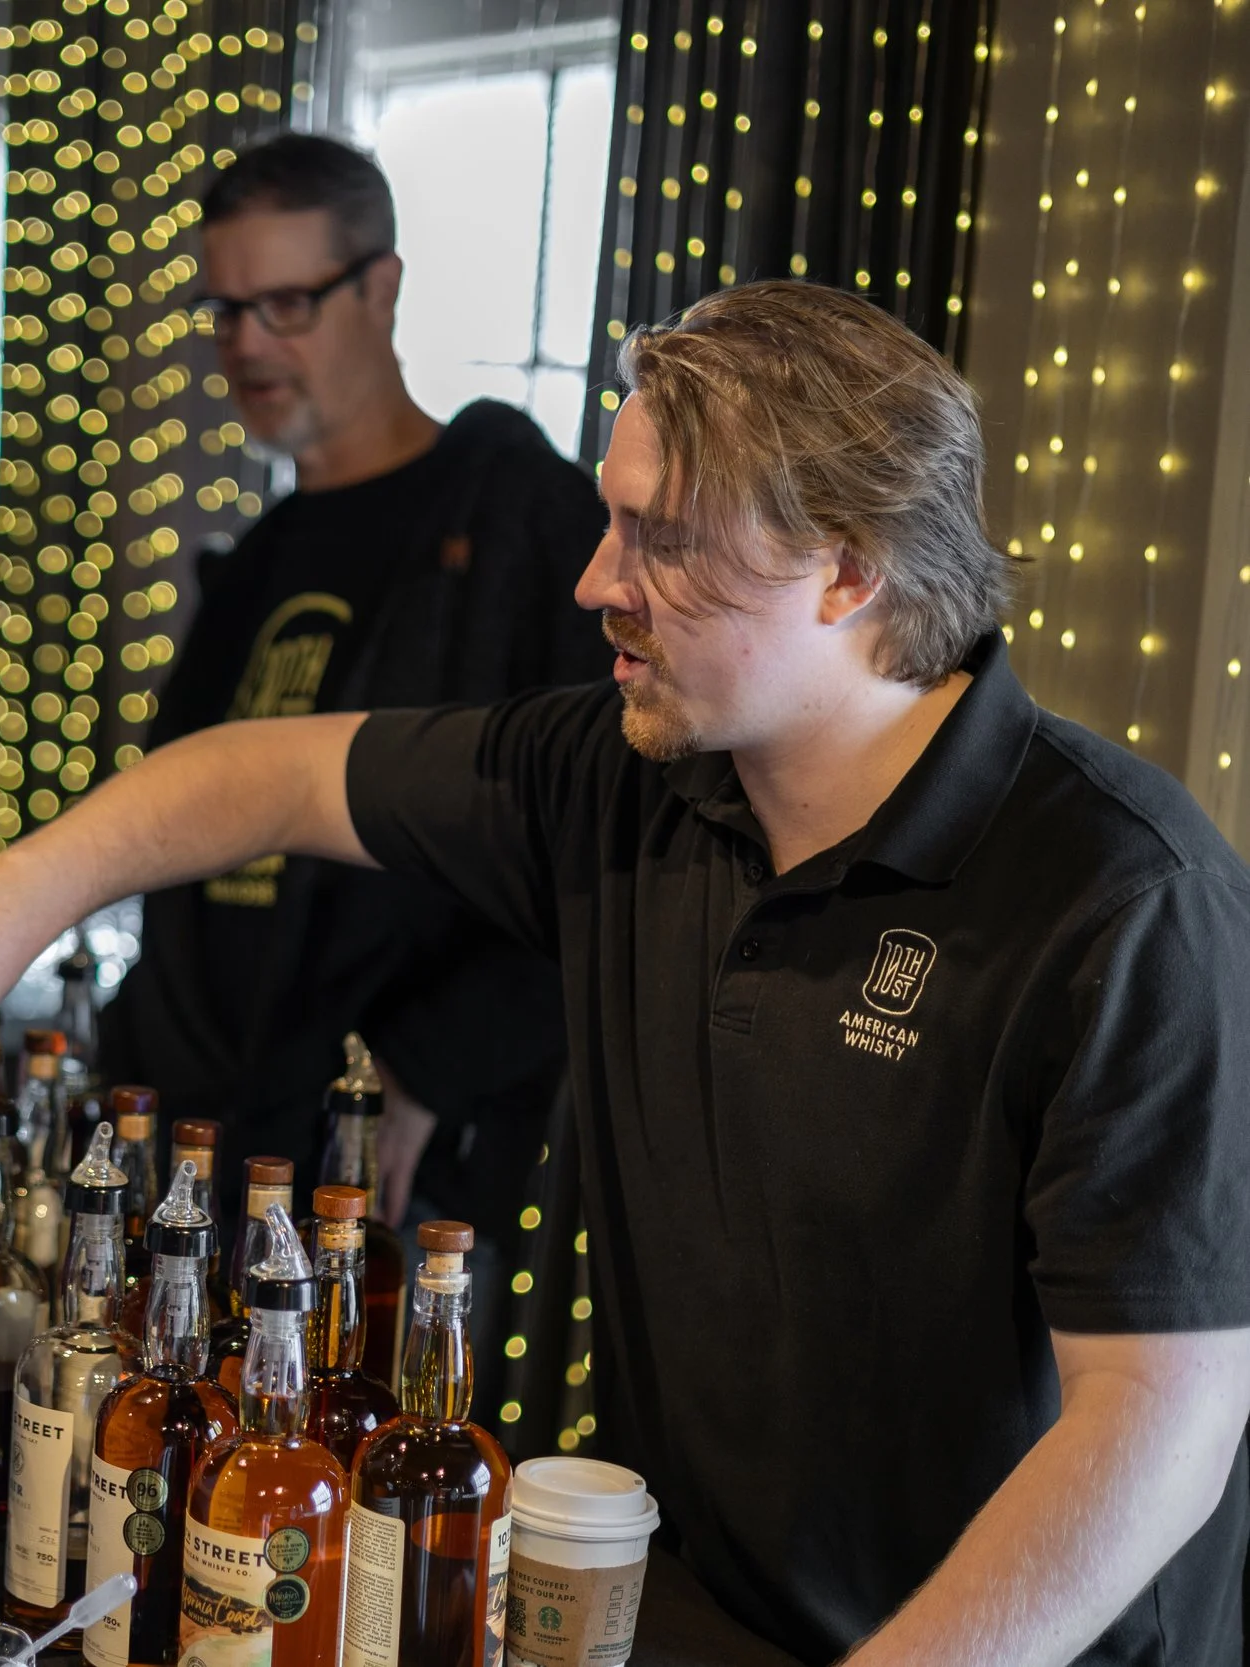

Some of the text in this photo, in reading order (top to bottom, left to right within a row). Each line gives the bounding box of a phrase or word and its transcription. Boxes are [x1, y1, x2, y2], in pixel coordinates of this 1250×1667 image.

[891, 979, 913, 1001] ST
[839, 1009, 919, 1047] AMERICAN
[844, 1028, 906, 1061] WHISKY
[136, 1481, 159, 1498] 96
[194, 1536, 265, 1568] STREET
[201, 1558, 232, 1574] WHISKY
[236, 1567, 252, 1577] CO.
[515, 1570, 530, 1582] FREE
[533, 1577, 570, 1591] COFFEE?
[517, 1582, 578, 1603] LOVE OUR APP.
[215, 1594, 263, 1628] Coast
